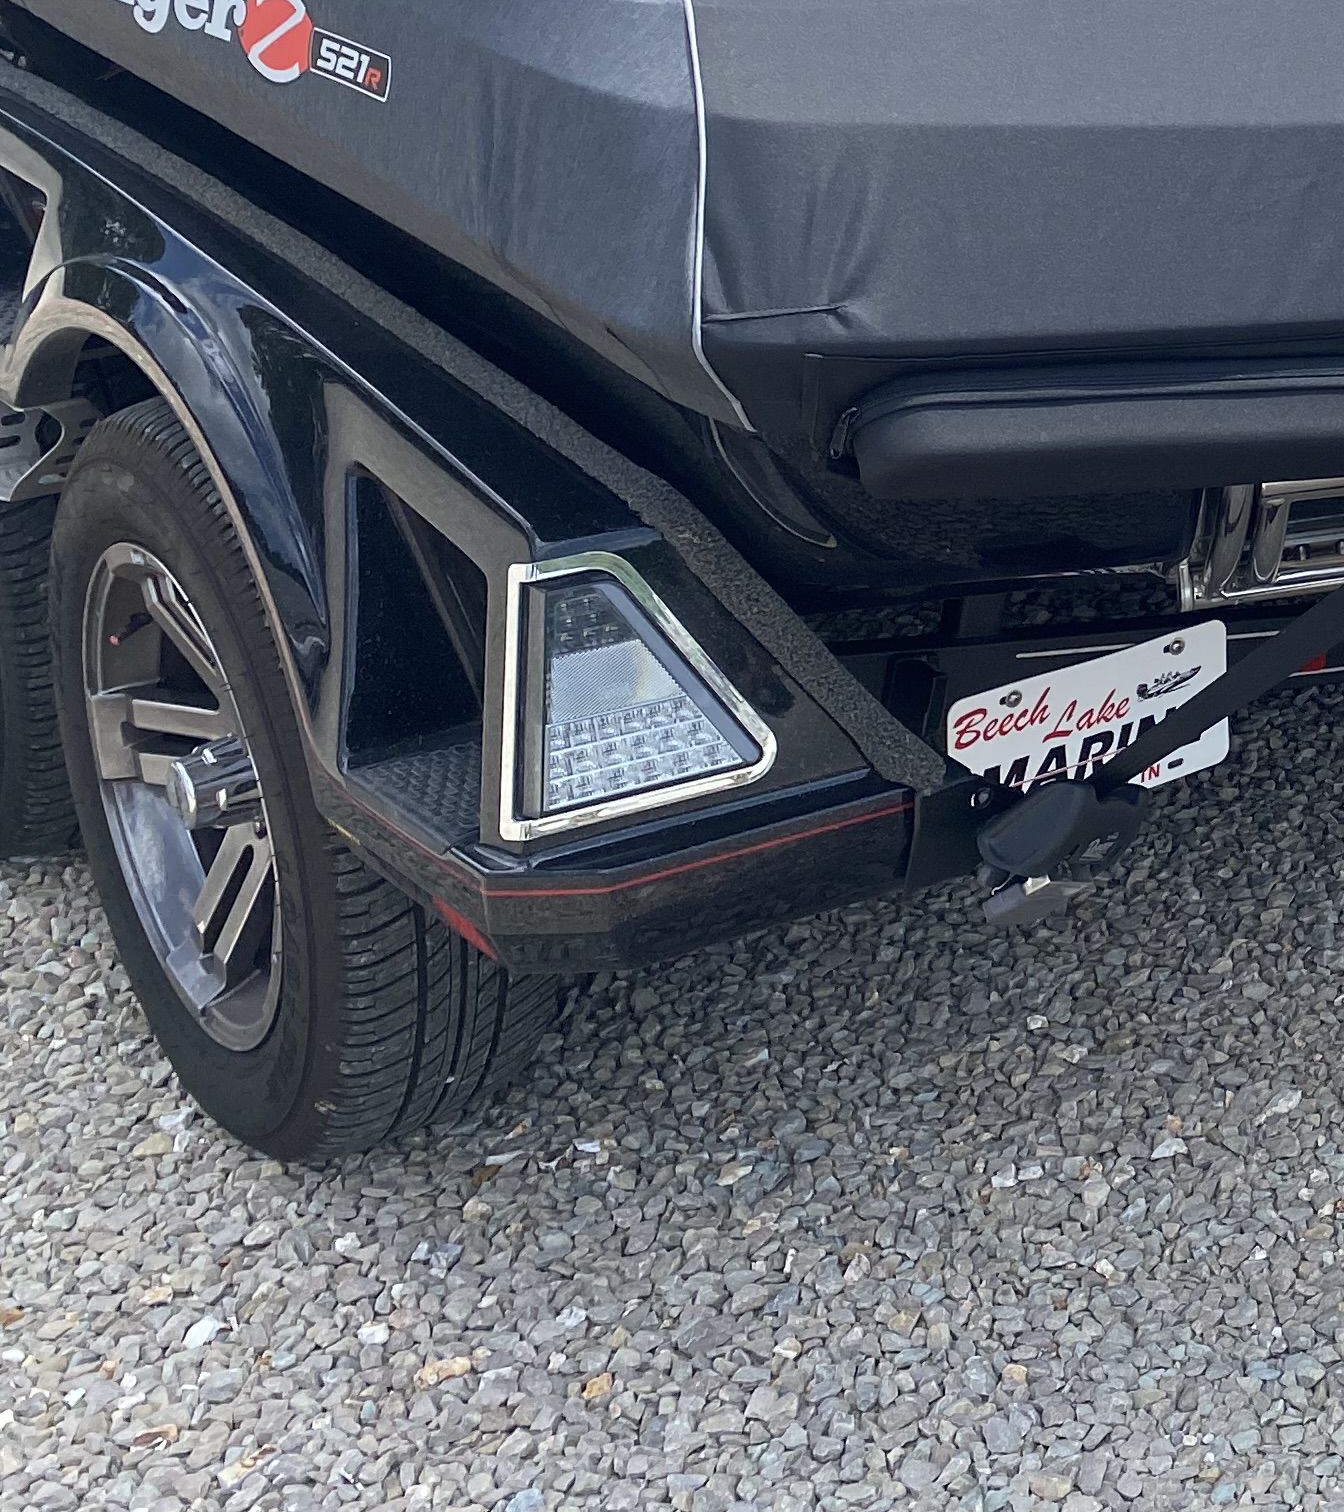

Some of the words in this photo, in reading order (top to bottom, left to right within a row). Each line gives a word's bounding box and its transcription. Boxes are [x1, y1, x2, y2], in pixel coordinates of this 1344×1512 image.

[316, 37, 382, 90] 521R
[953, 687, 1051, 750] Beech
[1043, 689, 1130, 743] Lake
[983, 706, 1177, 793] MARI
